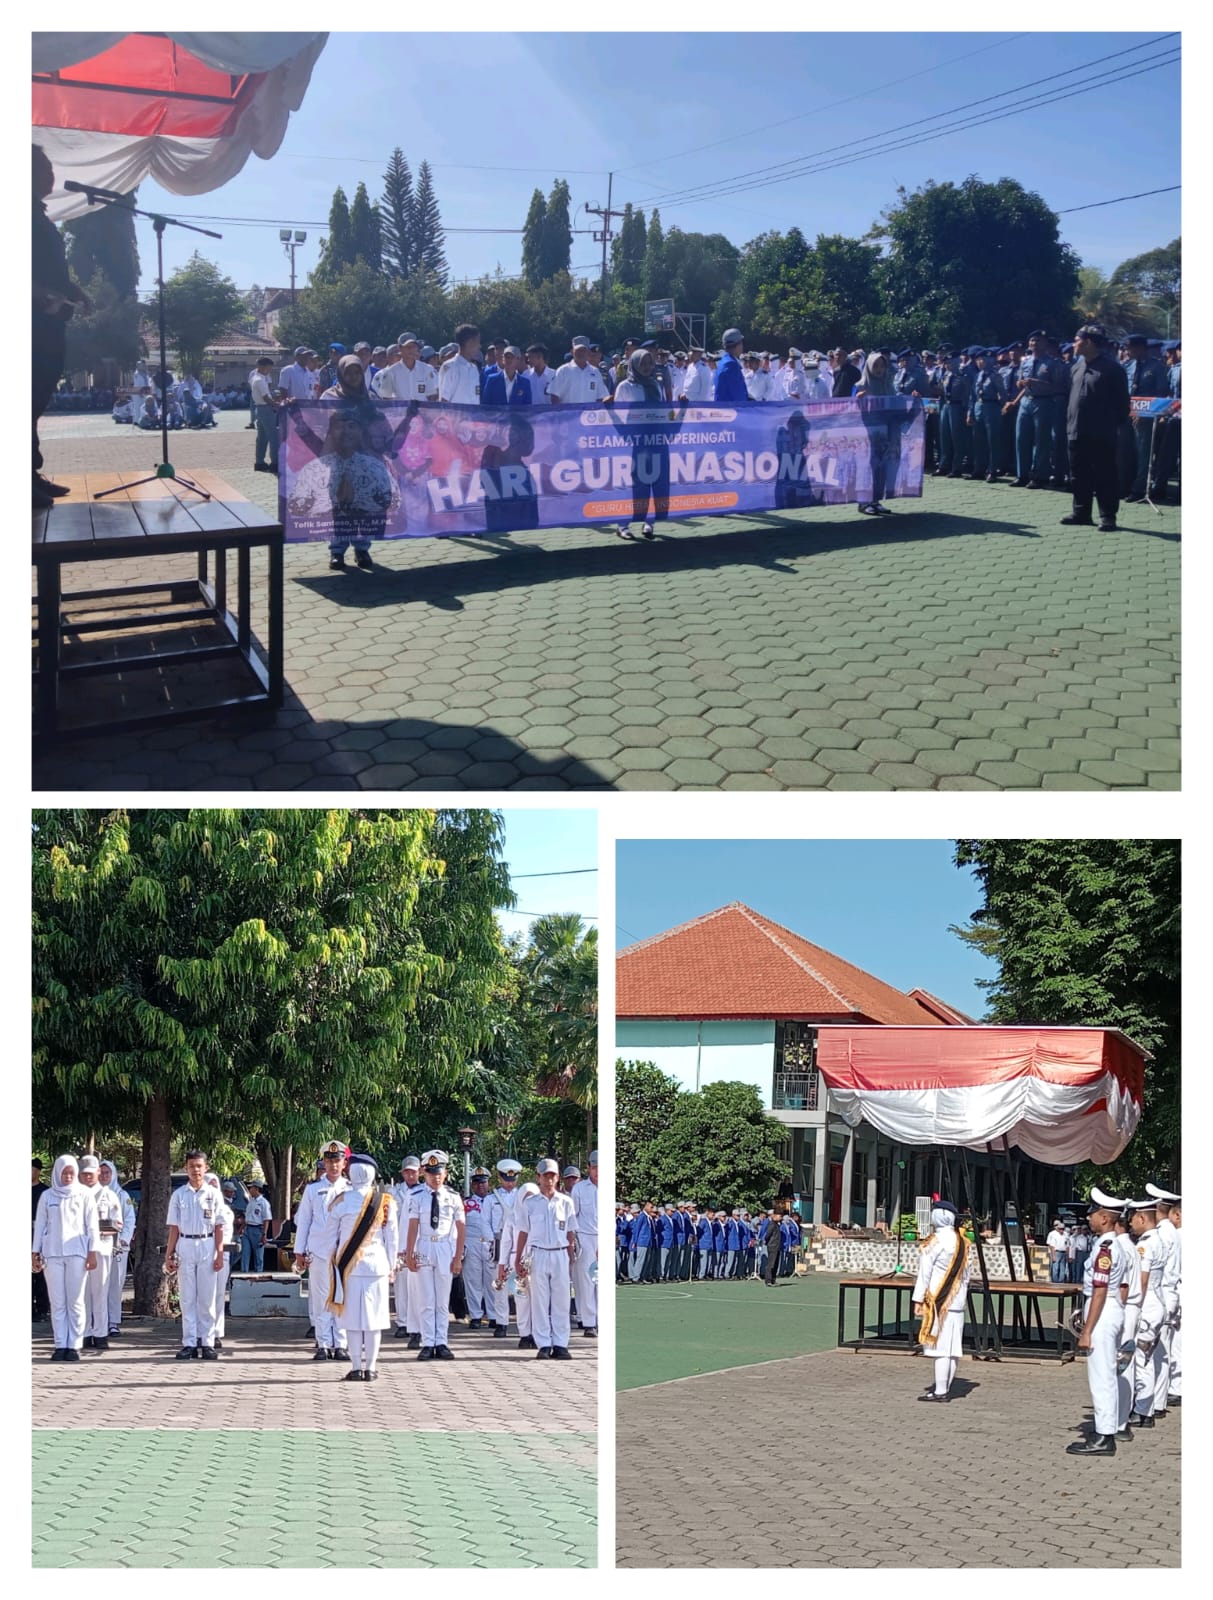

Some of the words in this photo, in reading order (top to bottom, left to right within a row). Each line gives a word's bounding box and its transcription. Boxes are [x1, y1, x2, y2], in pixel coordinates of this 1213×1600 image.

[579, 434, 641, 449] SELAMAT
[644, 431, 736, 447] MEMPERINGATI
[427, 459, 543, 512] HARI
[551, 452, 661, 492] GURU
[669, 450, 839, 486] NASIONAL
